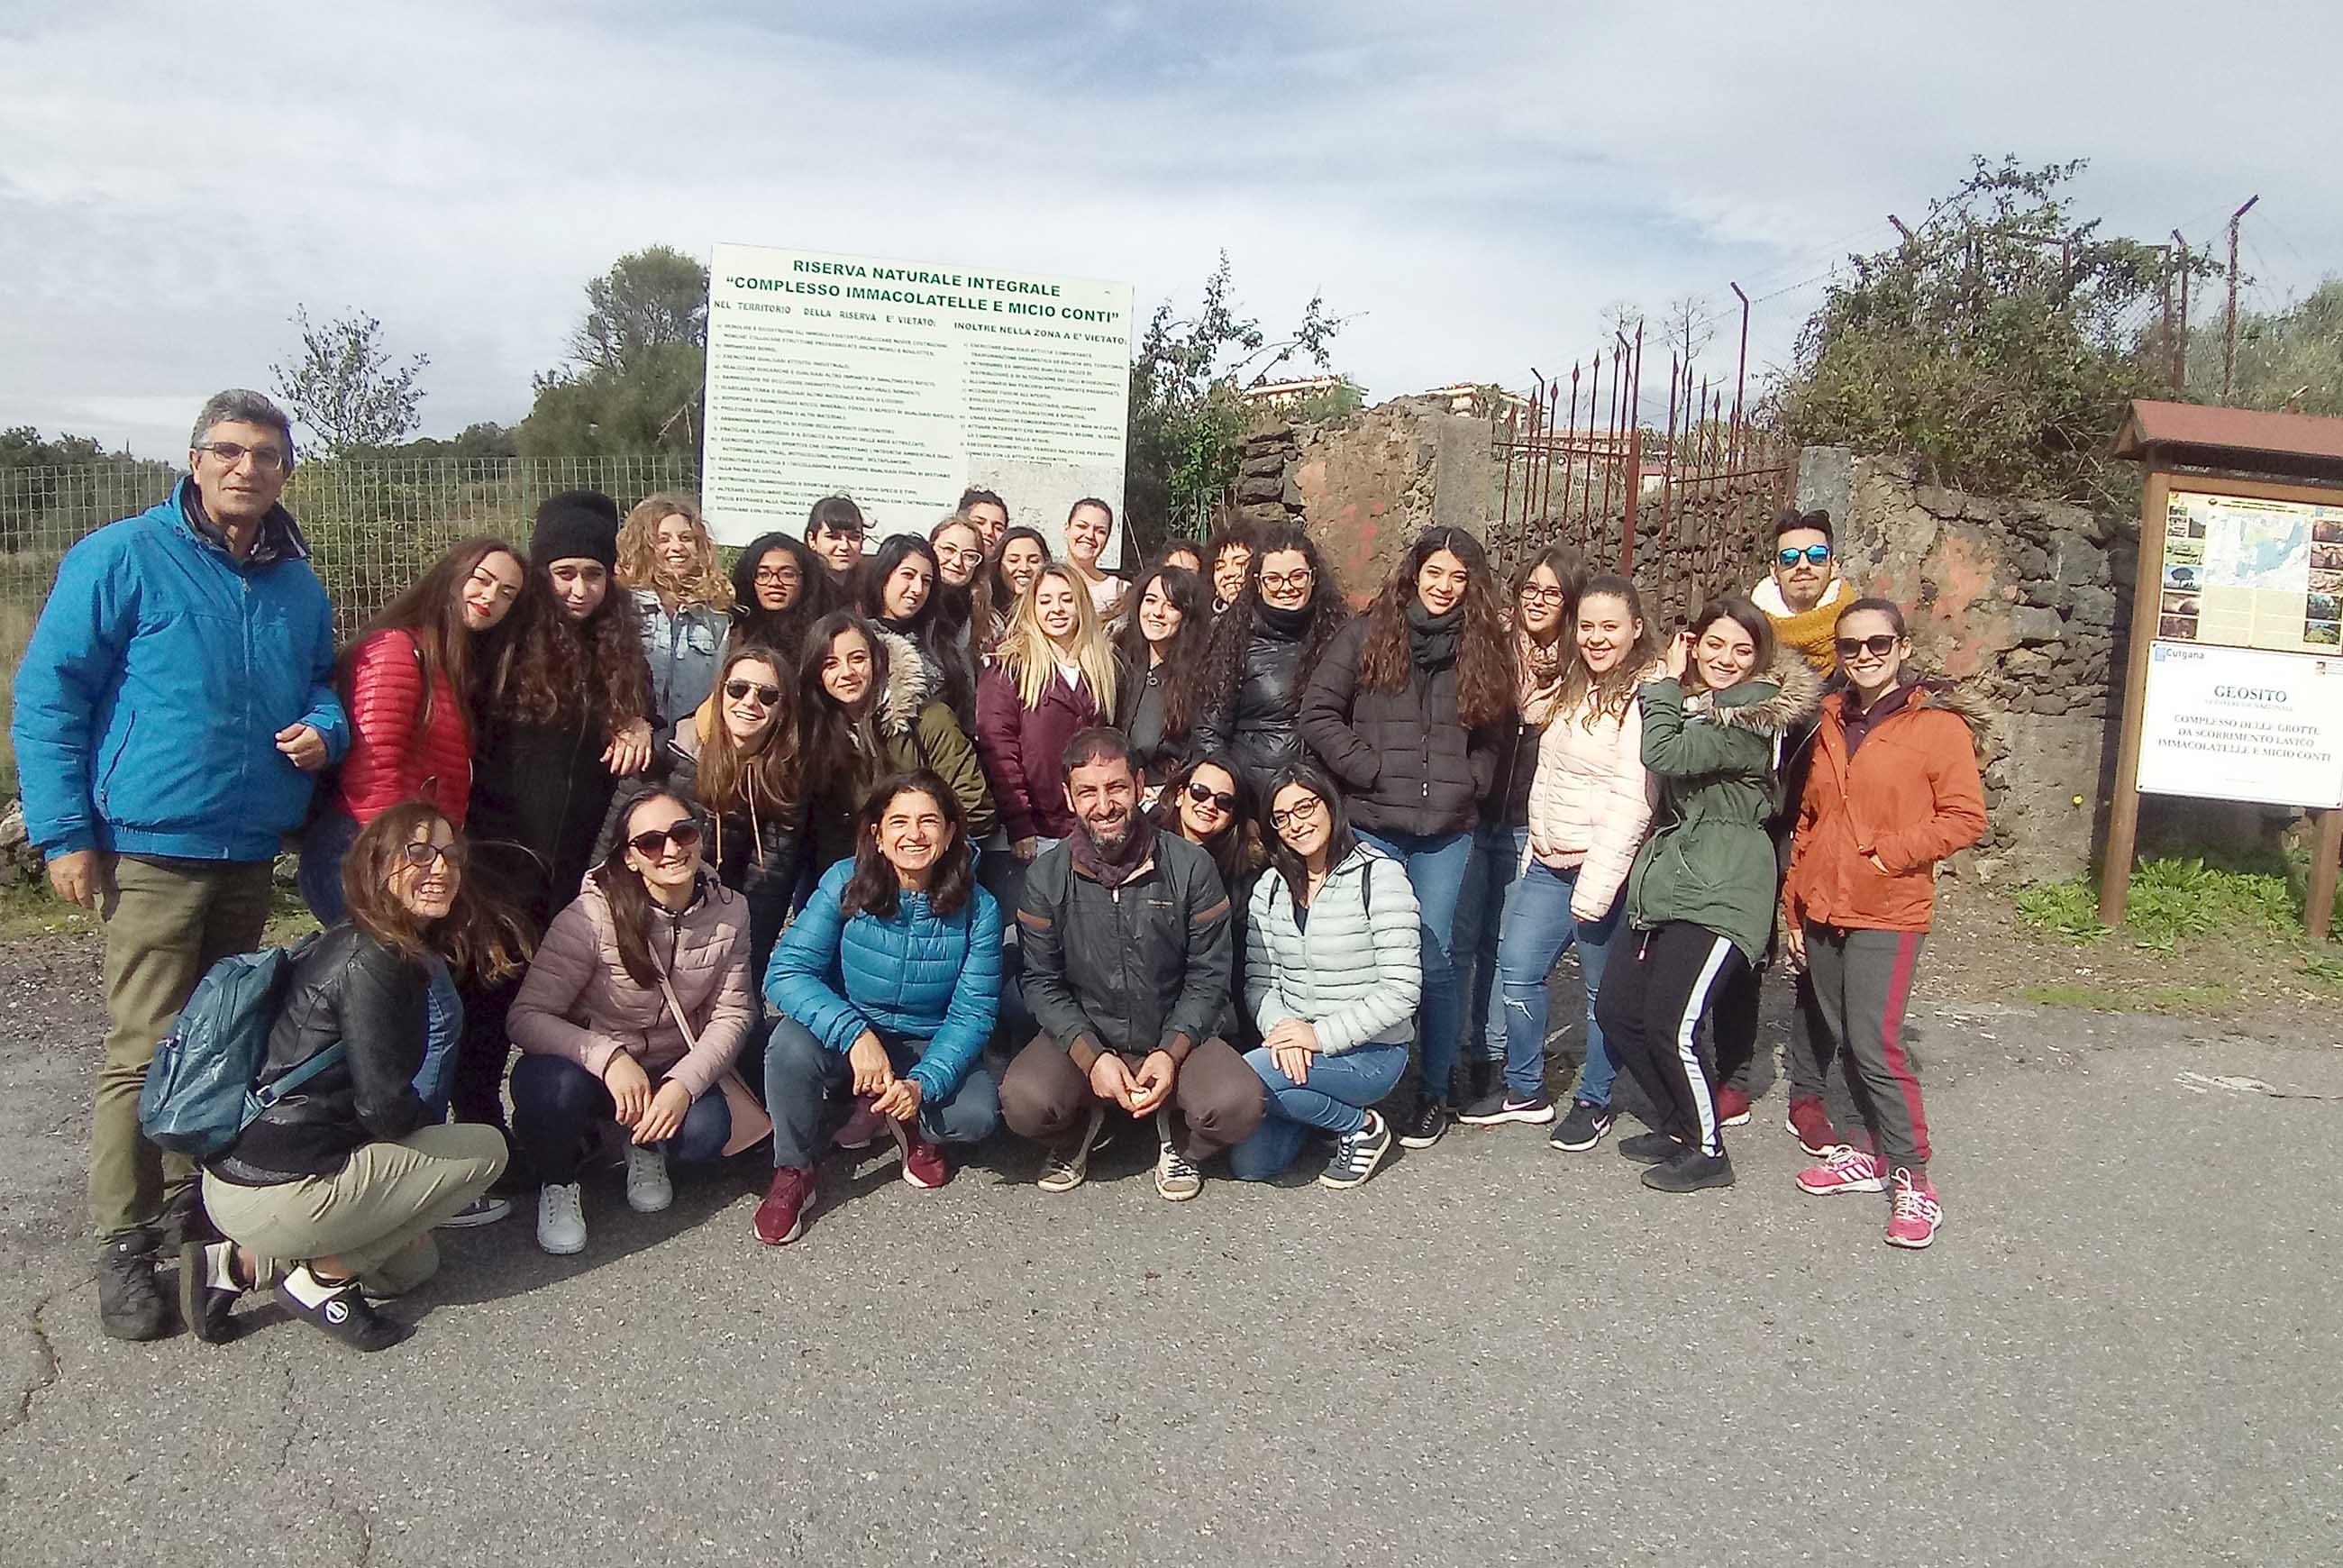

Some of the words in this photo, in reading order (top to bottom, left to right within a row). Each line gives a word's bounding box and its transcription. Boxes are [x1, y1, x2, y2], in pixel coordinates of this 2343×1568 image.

[794, 260, 866, 278] RISERVA
[873, 268, 962, 287] NATURALE
[968, 278, 1060, 296] INTEGRALE
[715, 301, 731, 309] NEL
[737, 303, 790, 314] TERRITORIO
[804, 308, 831, 317] DELLA
[840, 311, 876, 321] RISERVA
[847, 287, 987, 310] IMMACOLATELLE
[994, 301, 1002, 312] E
[1009, 303, 1055, 317] MICIO
[954, 323, 996, 333] INOLTRE
[1000, 326, 1030, 335] NELLA
[1034, 330, 1061, 338] ZONA
[2166, 648, 2204, 661] Cutgana
[2214, 685, 2288, 703] GEOSITO
[2174, 714, 2238, 728] COMPLESSO
[2240, 720, 2274, 731] DELLE
[2277, 724, 2321, 735] GROTTE
[2178, 728, 2193, 736] DA
[2195, 728, 2274, 744] SCORRIMENTO
[2275, 736, 2315, 748] LAVICO
[2158, 738, 2249, 754] IMMACOLATELLE
[2263, 748, 2295, 759] MICIO
[2297, 751, 2331, 762] CONTI
